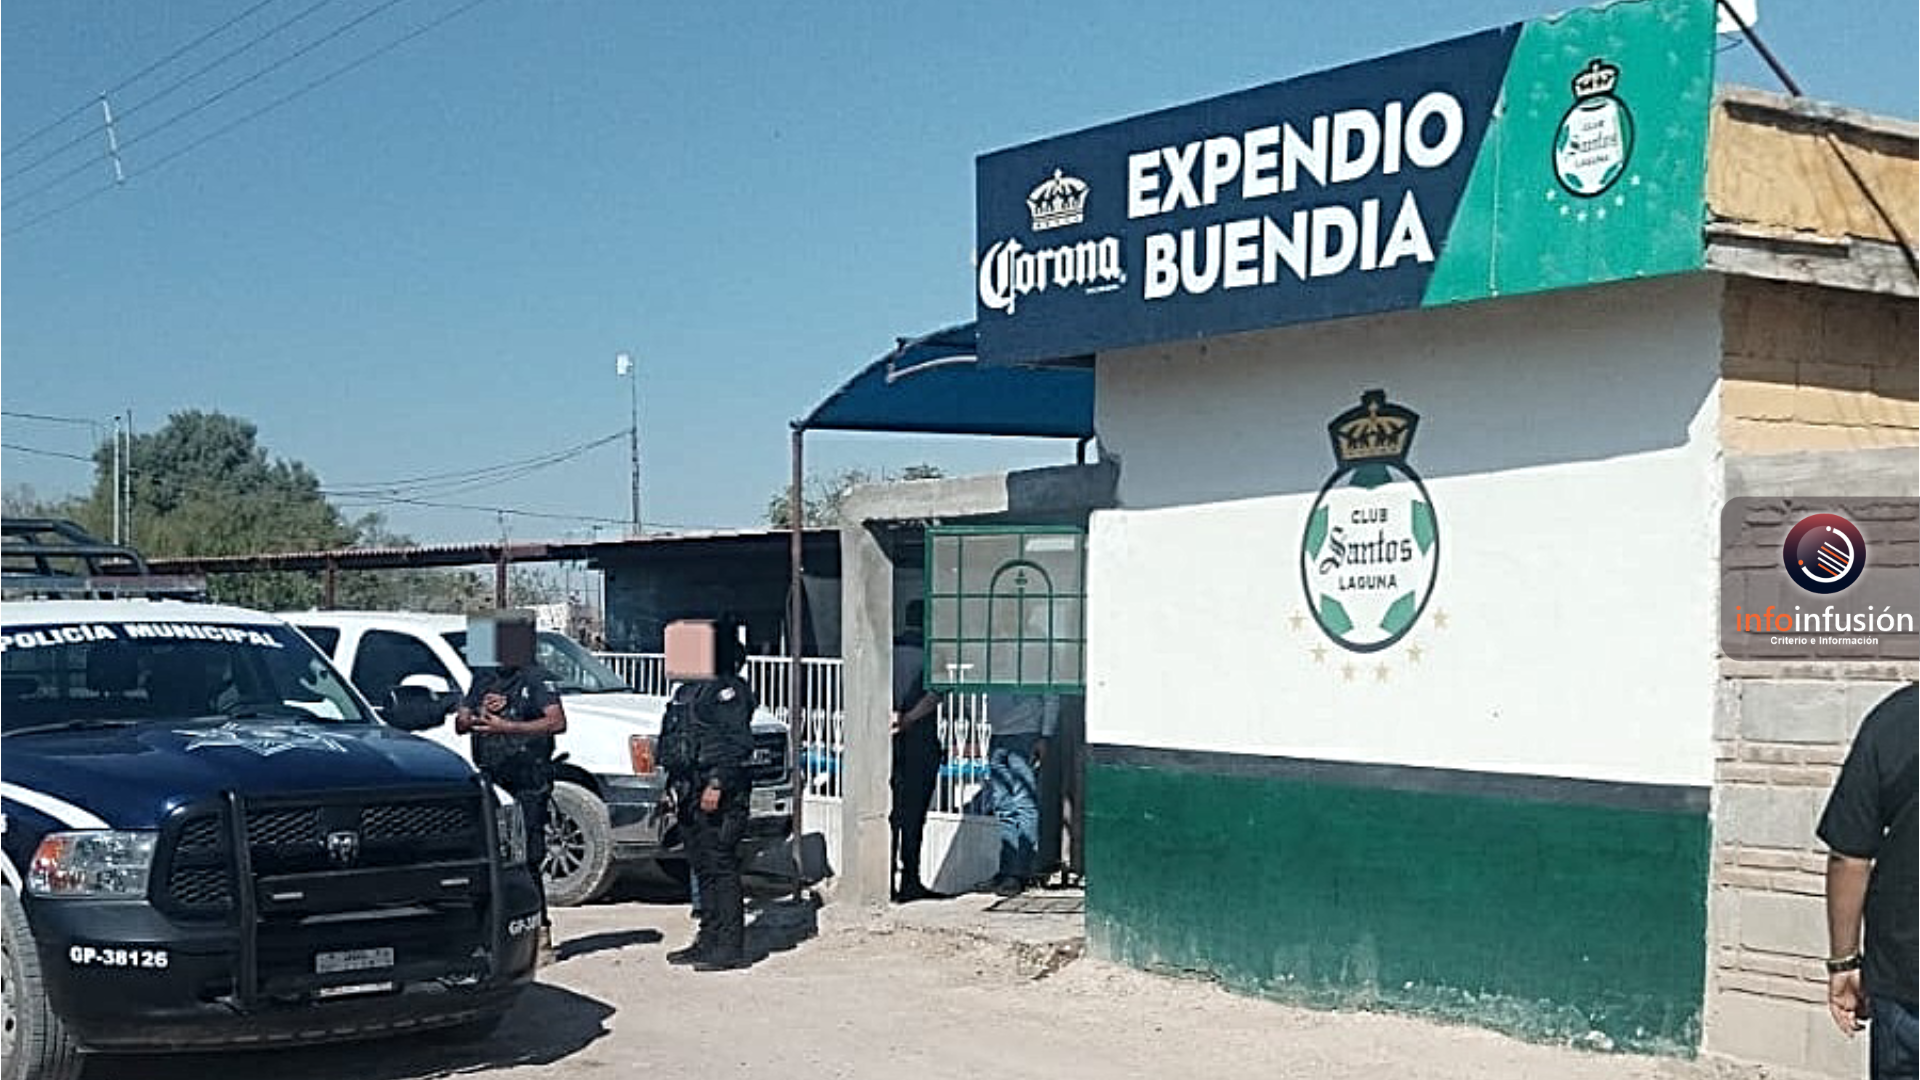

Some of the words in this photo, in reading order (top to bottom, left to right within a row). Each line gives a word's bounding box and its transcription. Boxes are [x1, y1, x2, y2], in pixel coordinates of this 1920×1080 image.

[1127, 91, 1465, 220] EXPENDIO
[1144, 188, 1436, 300] BUENDIA
[979, 236, 1121, 315] Corona
[1351, 507, 1389, 525] CLUB
[1319, 526, 1413, 575] Santos
[1338, 574, 1398, 591] LAGUNA
[122, 623, 284, 648] MUNICIPAL
